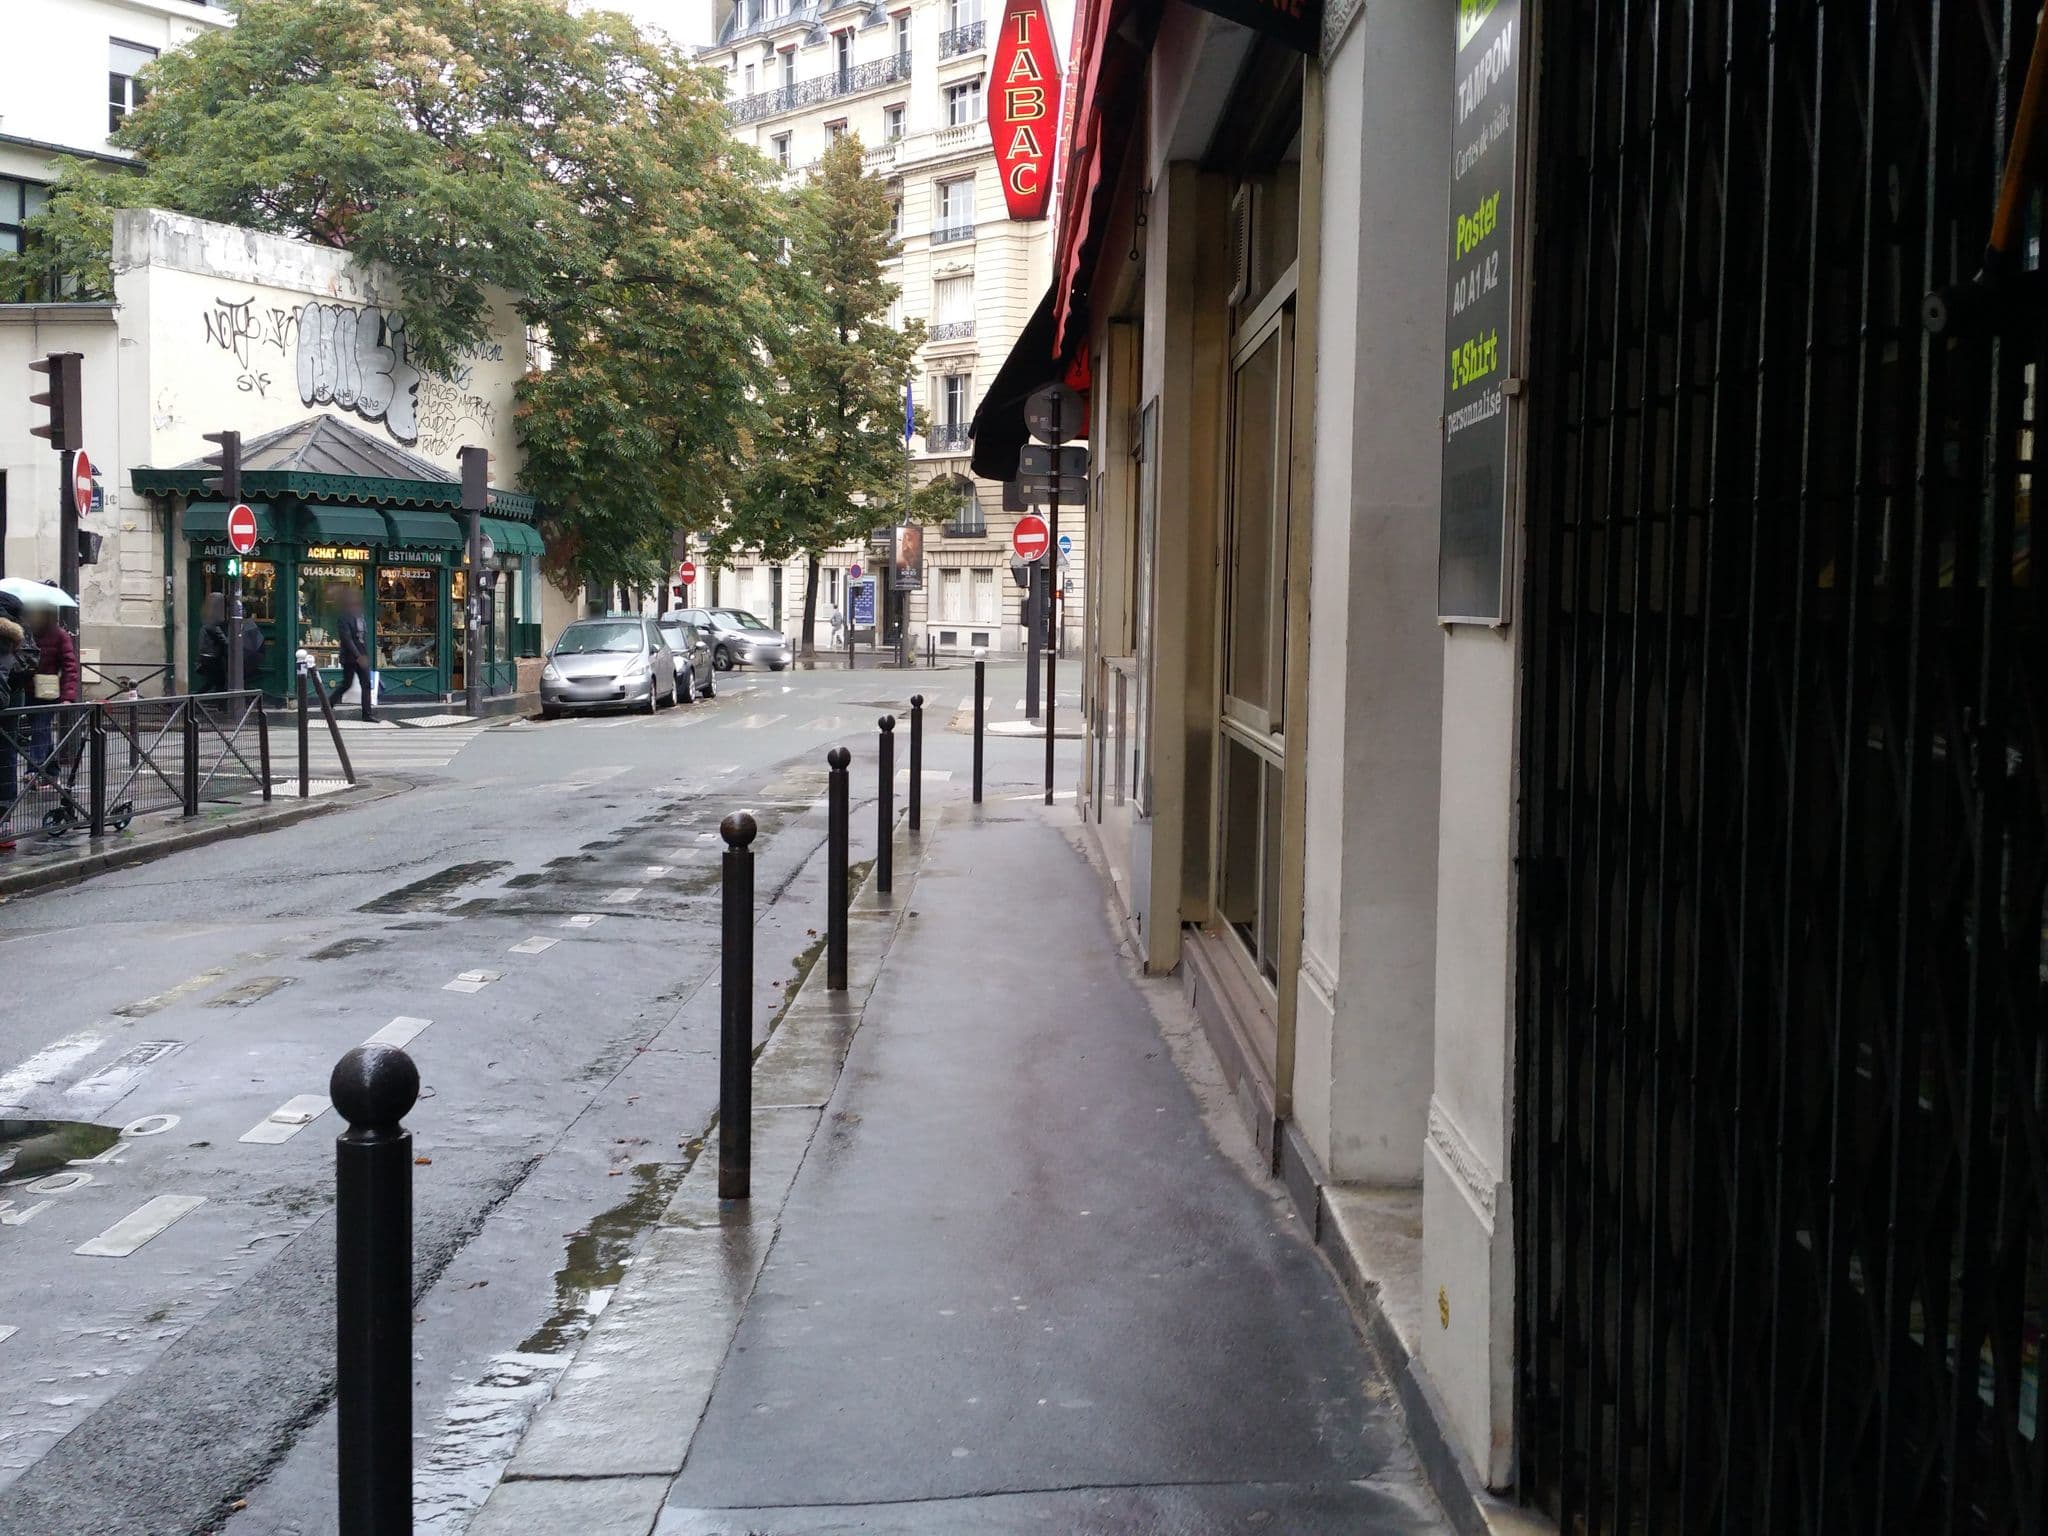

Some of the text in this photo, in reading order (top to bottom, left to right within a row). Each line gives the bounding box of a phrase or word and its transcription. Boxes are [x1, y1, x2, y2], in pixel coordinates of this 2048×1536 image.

[1004, 10, 1046, 195] TABAC
[1459, 20, 1512, 125] TAMPON
[1456, 103, 1511, 180] Cartes de visite
[1456, 190, 1499, 261] Poster
[1467, 262, 1481, 306] A1
[1483, 249, 1498, 294] A2
[1452, 327, 1498, 391] T-Shirt
[1447, 381, 1502, 443] personnalisé
[204, 545, 261, 556] ANTIES
[388, 551, 442, 562] ESTIMATION
